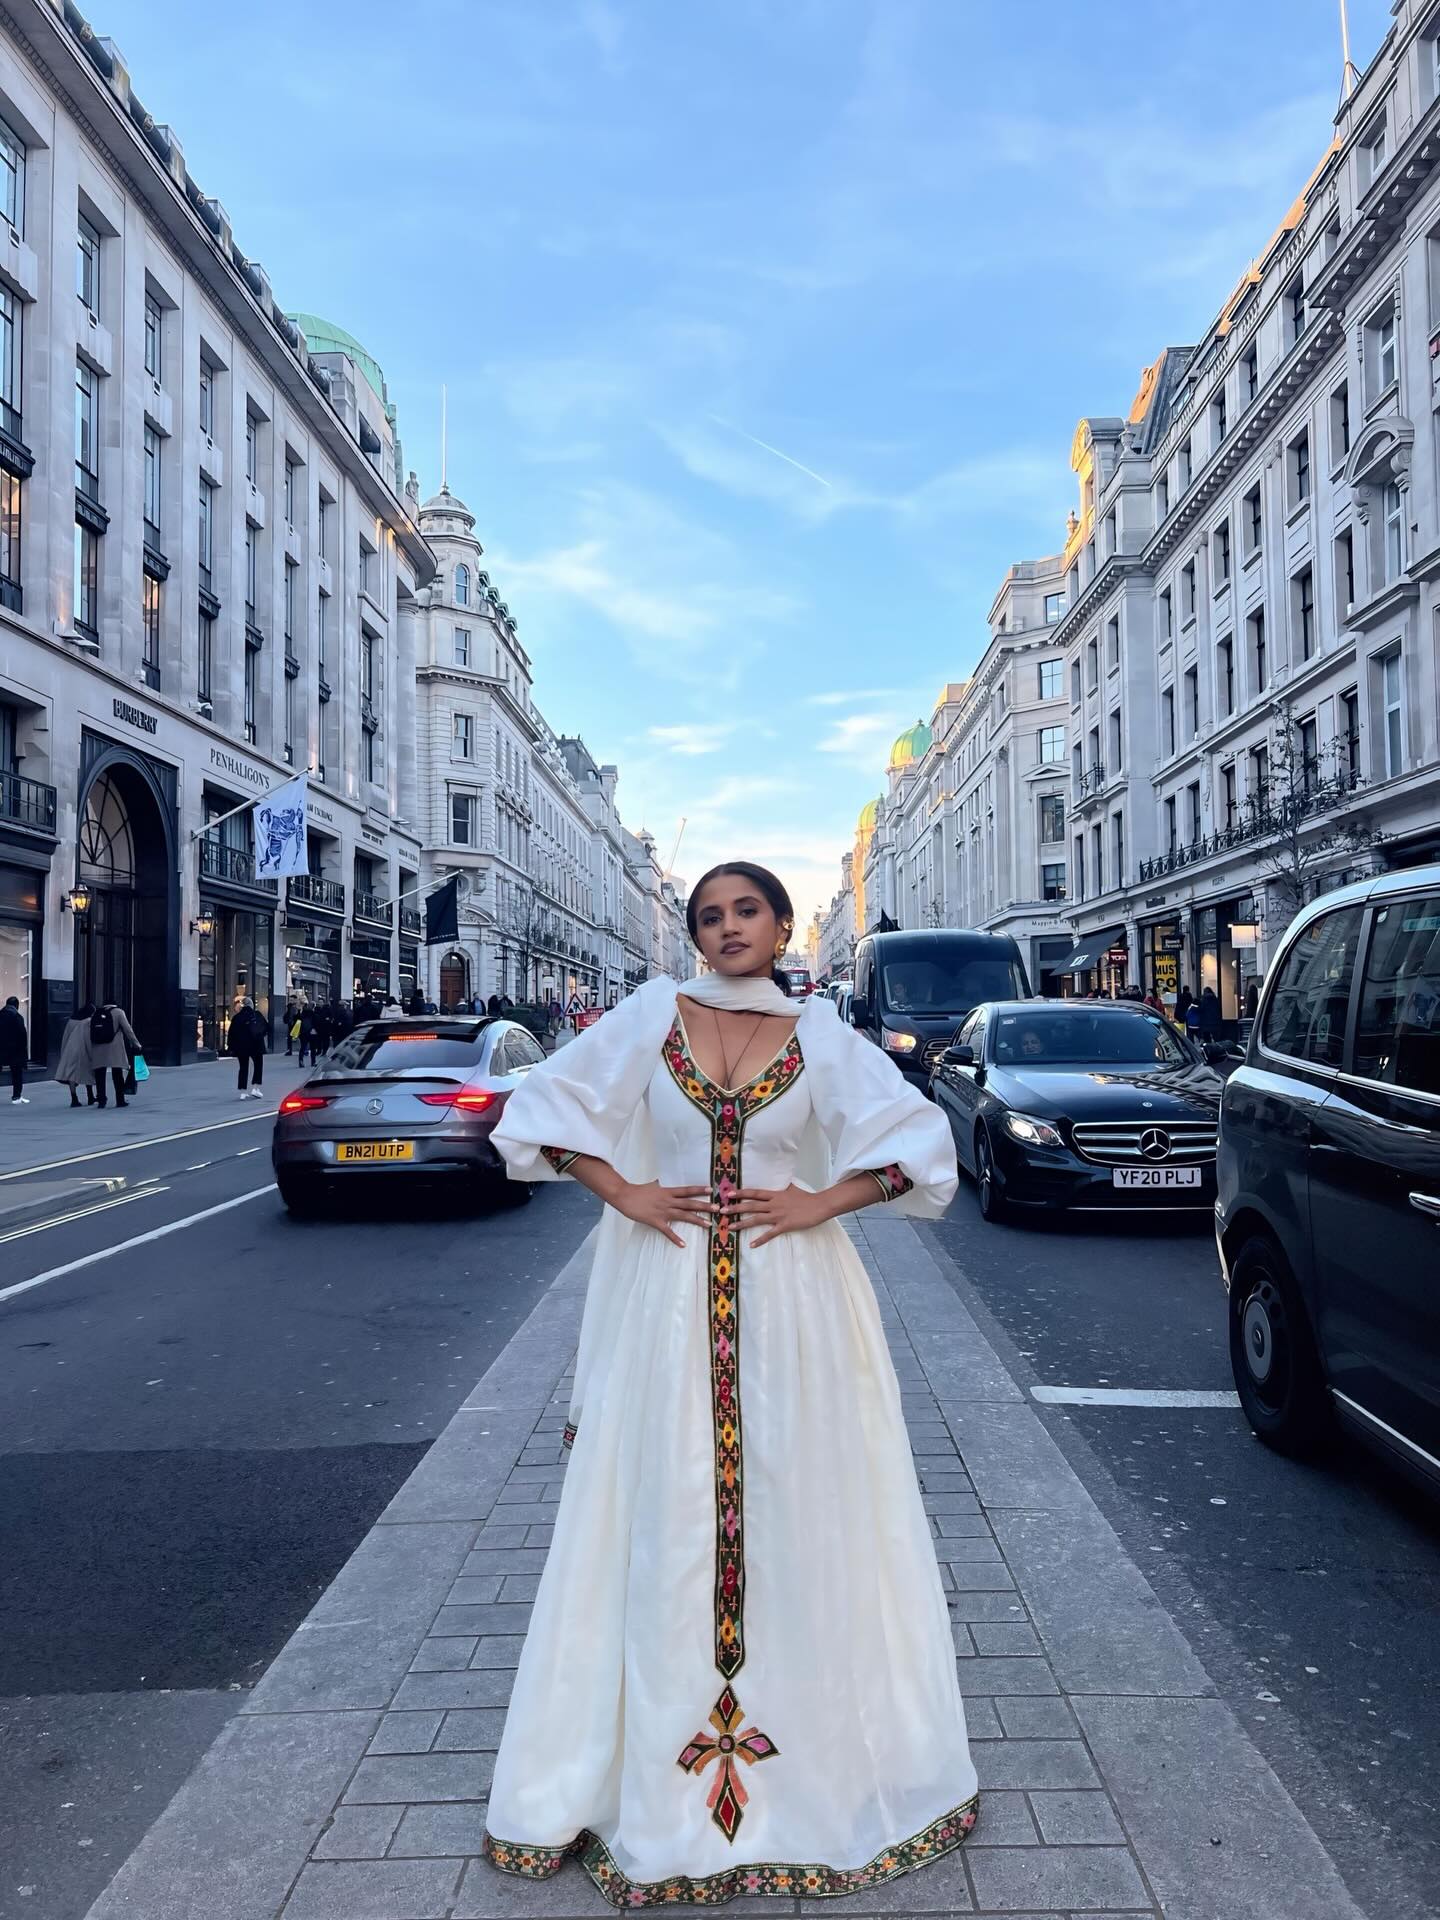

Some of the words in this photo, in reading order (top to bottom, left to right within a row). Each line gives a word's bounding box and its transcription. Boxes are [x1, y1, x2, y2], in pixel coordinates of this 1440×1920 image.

[112, 698, 158, 735] BURBERRY
[210, 748, 270, 789] PENHALIGON'S
[1156, 964, 1177, 975] MUS
[345, 1145, 375, 1158] BN21
[378, 1144, 405, 1157] UTP
[1120, 1170, 1160, 1185] YF20
[1165, 1170, 1195, 1185] PLJ
